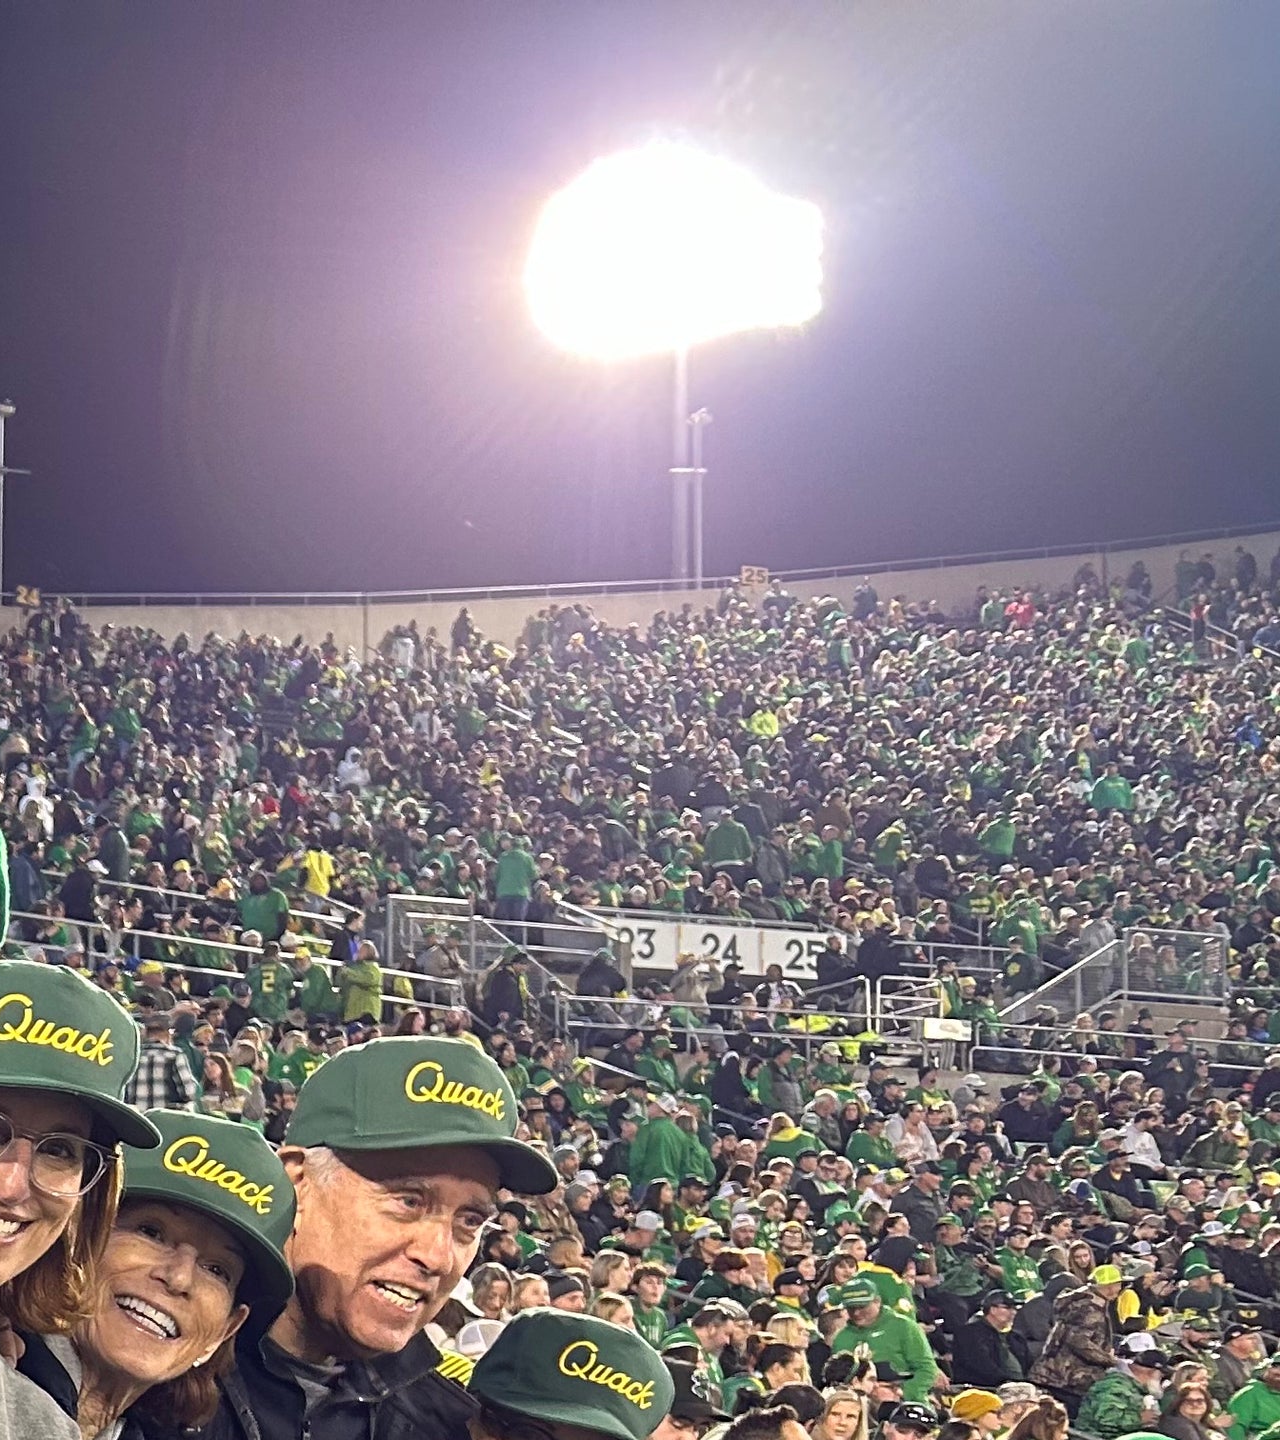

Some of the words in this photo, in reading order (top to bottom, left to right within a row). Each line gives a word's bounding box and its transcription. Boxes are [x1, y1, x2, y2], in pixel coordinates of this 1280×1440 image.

[744, 568, 766, 584] 25
[405, 1061, 505, 1120] Quack
[163, 1136, 274, 1214] Quack
[558, 1340, 655, 1409] Quack
